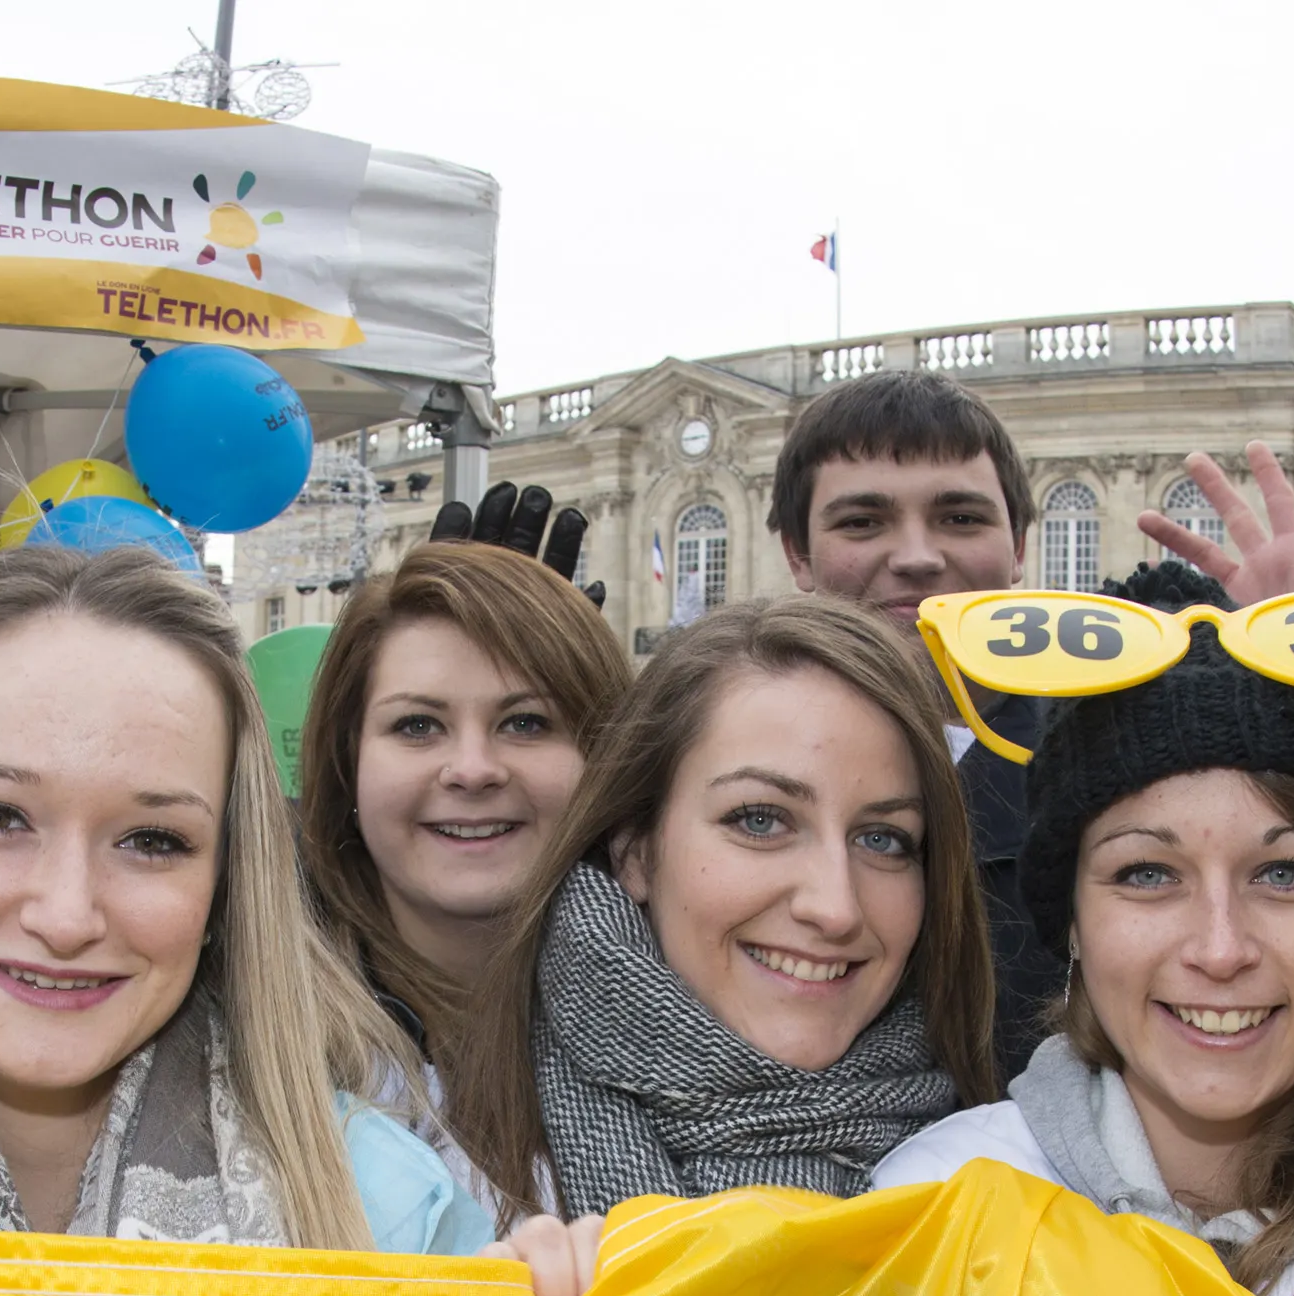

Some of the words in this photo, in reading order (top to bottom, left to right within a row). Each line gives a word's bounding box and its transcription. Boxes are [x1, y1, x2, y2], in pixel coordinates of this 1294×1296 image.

[32, 227, 93, 245] POUR
[97, 288, 325, 340] TELETHON.FR
[986, 605, 1124, 661] 36
